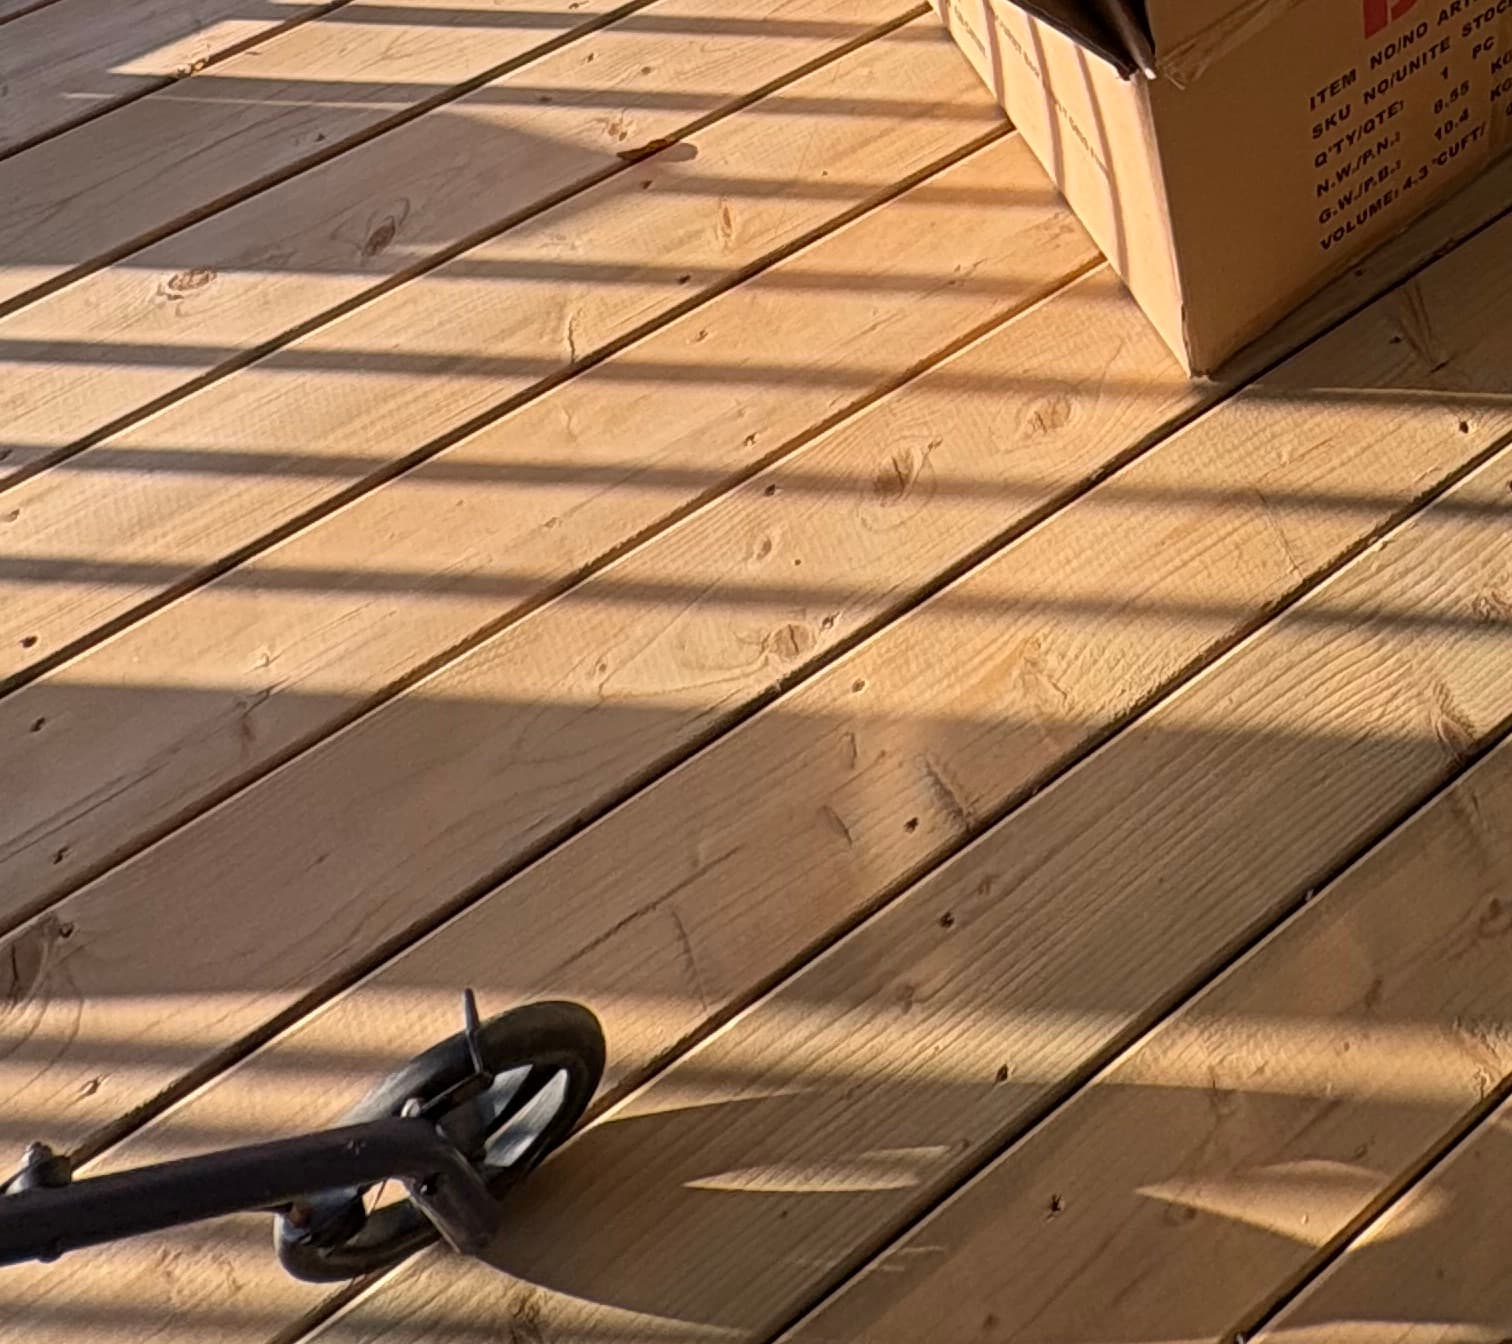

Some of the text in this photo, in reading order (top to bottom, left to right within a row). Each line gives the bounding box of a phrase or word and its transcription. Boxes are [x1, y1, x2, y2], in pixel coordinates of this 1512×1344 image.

[1308, 67, 1358, 112] ITEM
[1369, 21, 1429, 70] NO/NO
[1311, 103, 1352, 140] SKU
[1364, 36, 1451, 105] NO/UNITE
[1440, 66, 1449, 81] 1
[1471, 36, 1496, 60] PC
[1402, 165, 1429, 192] 4.3
